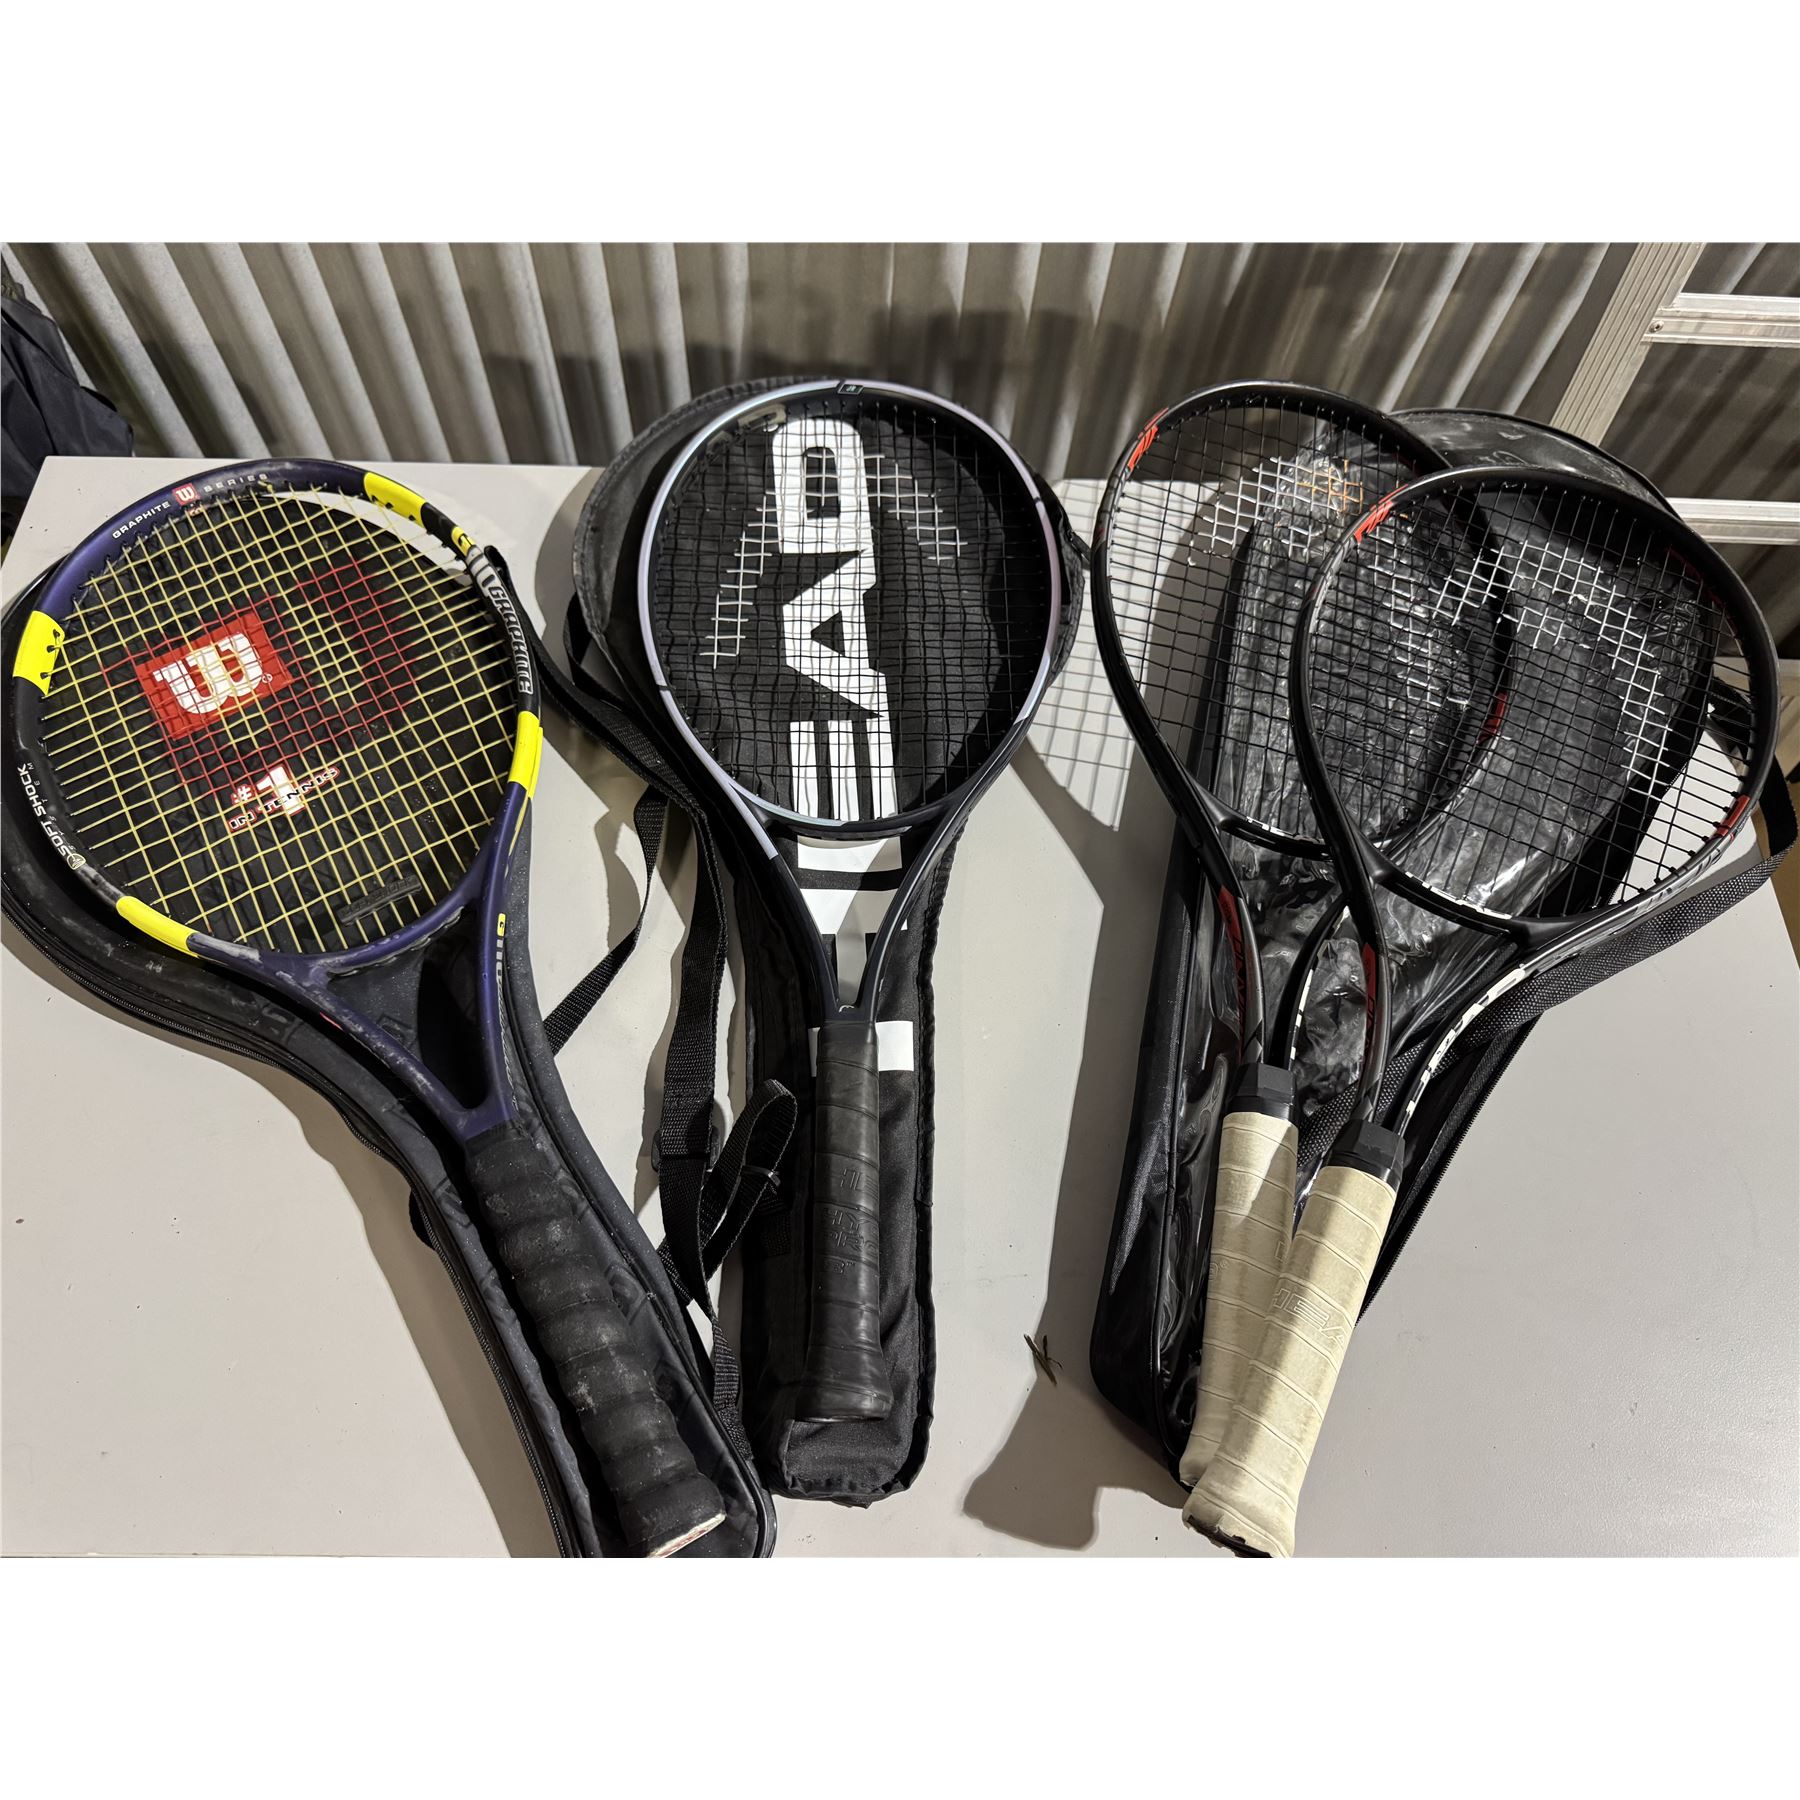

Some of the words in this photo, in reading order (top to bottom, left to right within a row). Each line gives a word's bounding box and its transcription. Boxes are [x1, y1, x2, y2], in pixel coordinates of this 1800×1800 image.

[112, 500, 171, 539] GRAPHITE
[203, 473, 268, 493] SERIES
[488, 584, 534, 695] GRAPHITE
[17, 763, 46, 817] SHOCK
[41, 820, 74, 858] SOFT
